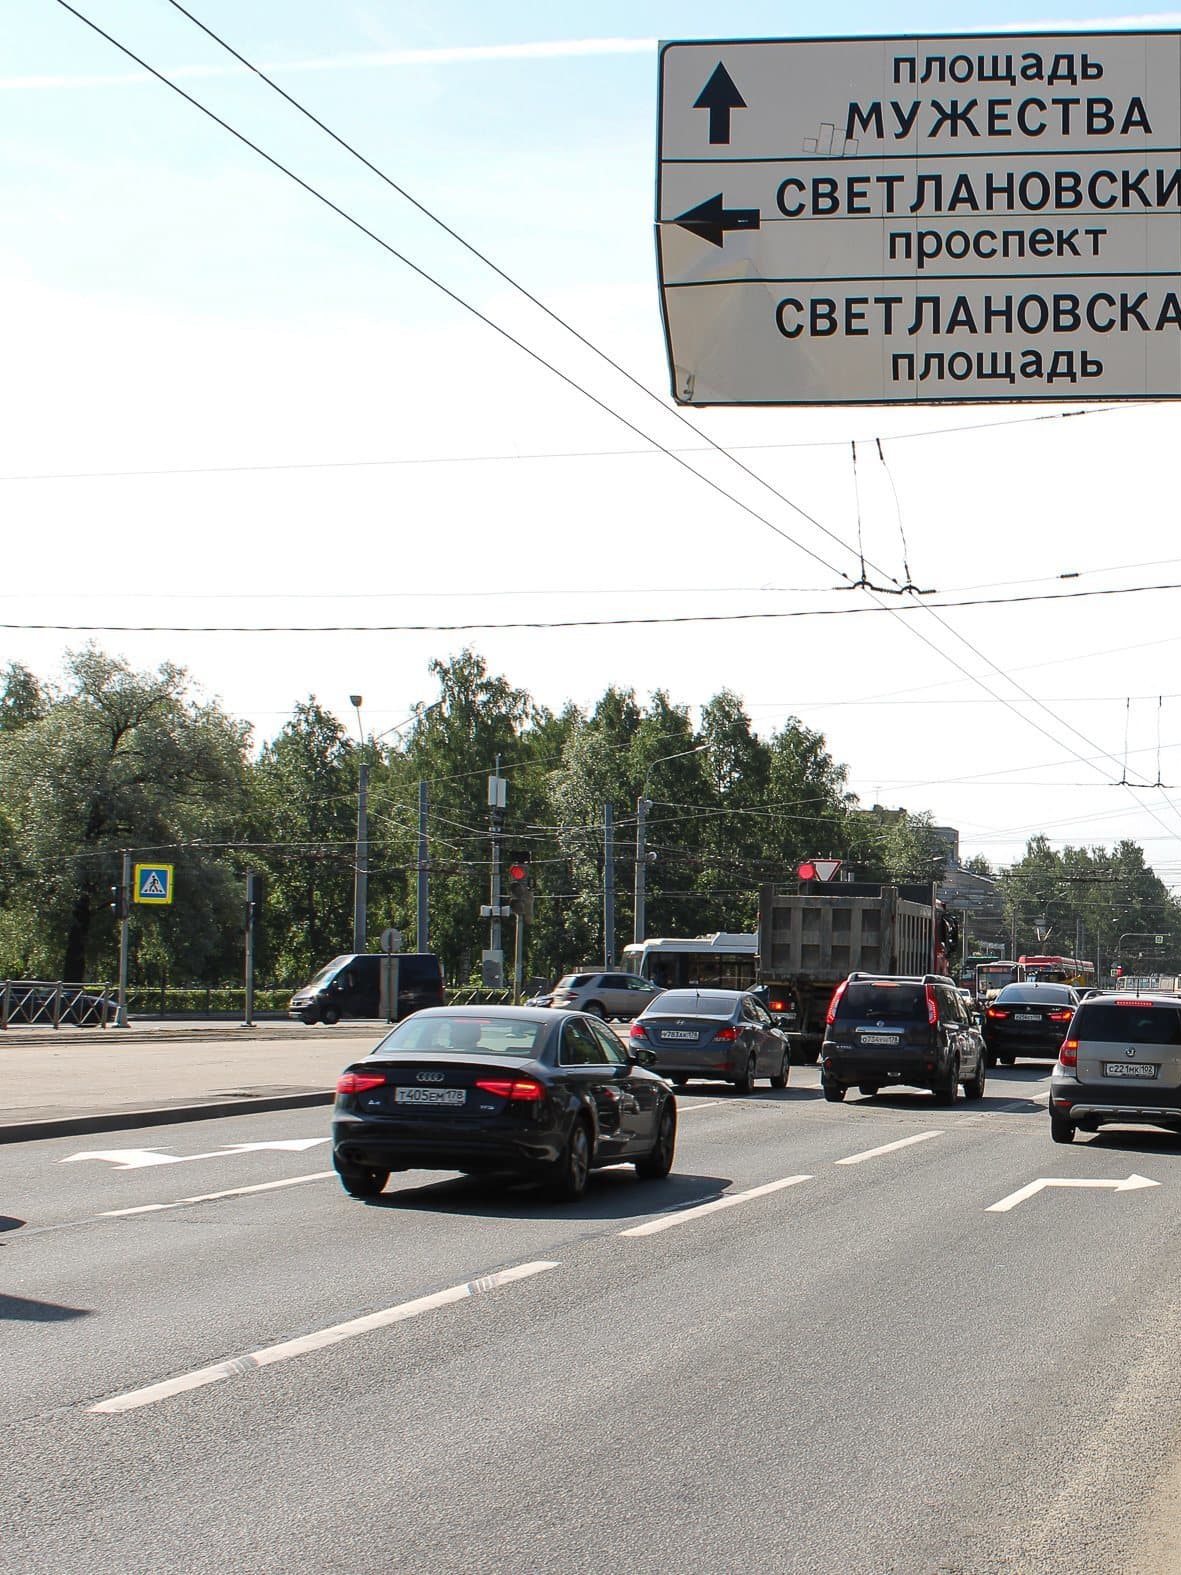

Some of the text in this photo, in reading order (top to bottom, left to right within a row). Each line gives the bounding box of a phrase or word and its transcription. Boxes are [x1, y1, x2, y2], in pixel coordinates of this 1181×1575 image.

[894, 53, 1103, 86] площадь
[847, 97, 1152, 140] МУЖЕСТВА
[888, 225, 1107, 267] проспект
[892, 350, 1103, 383] площадь
